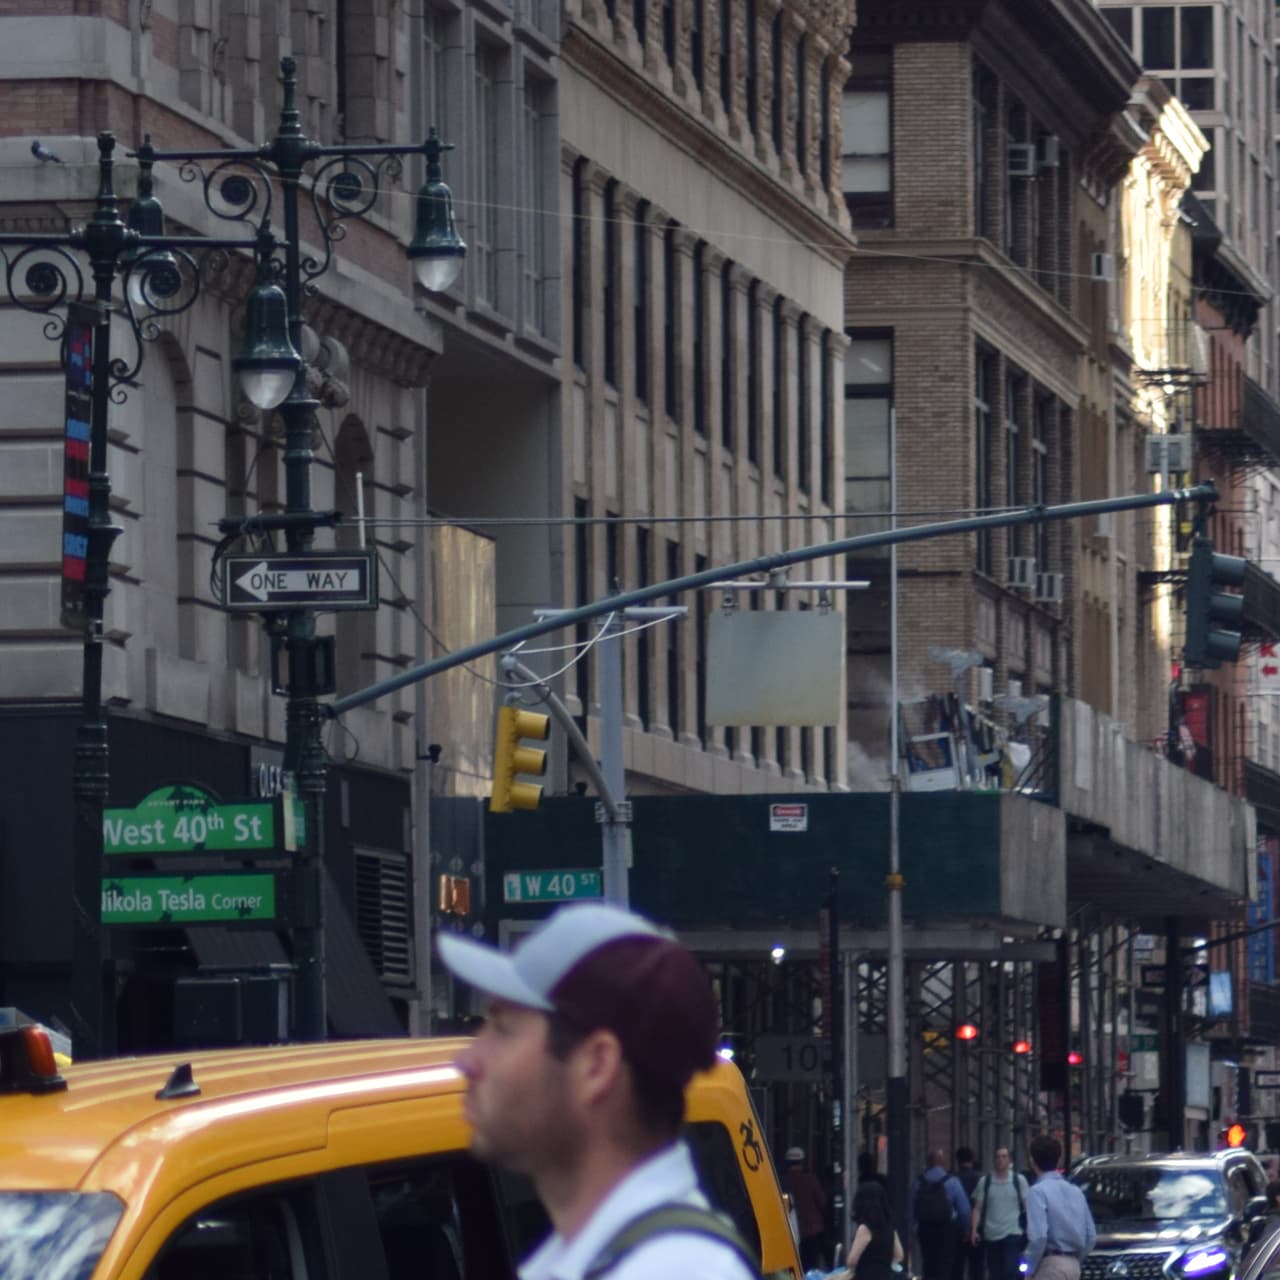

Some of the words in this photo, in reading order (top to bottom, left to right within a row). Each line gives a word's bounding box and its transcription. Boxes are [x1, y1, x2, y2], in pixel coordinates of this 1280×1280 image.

[250, 572, 288, 590] ONE
[305, 572, 348, 589] WAY
[103, 818, 166, 846] West
[172, 813, 224, 844] 40th
[233, 814, 263, 842] St
[525, 875, 541, 897] W
[547, 874, 576, 897] 40
[581, 873, 597, 886] ST
[158, 888, 206, 911] Tesla
[211, 893, 262, 910] Corner
